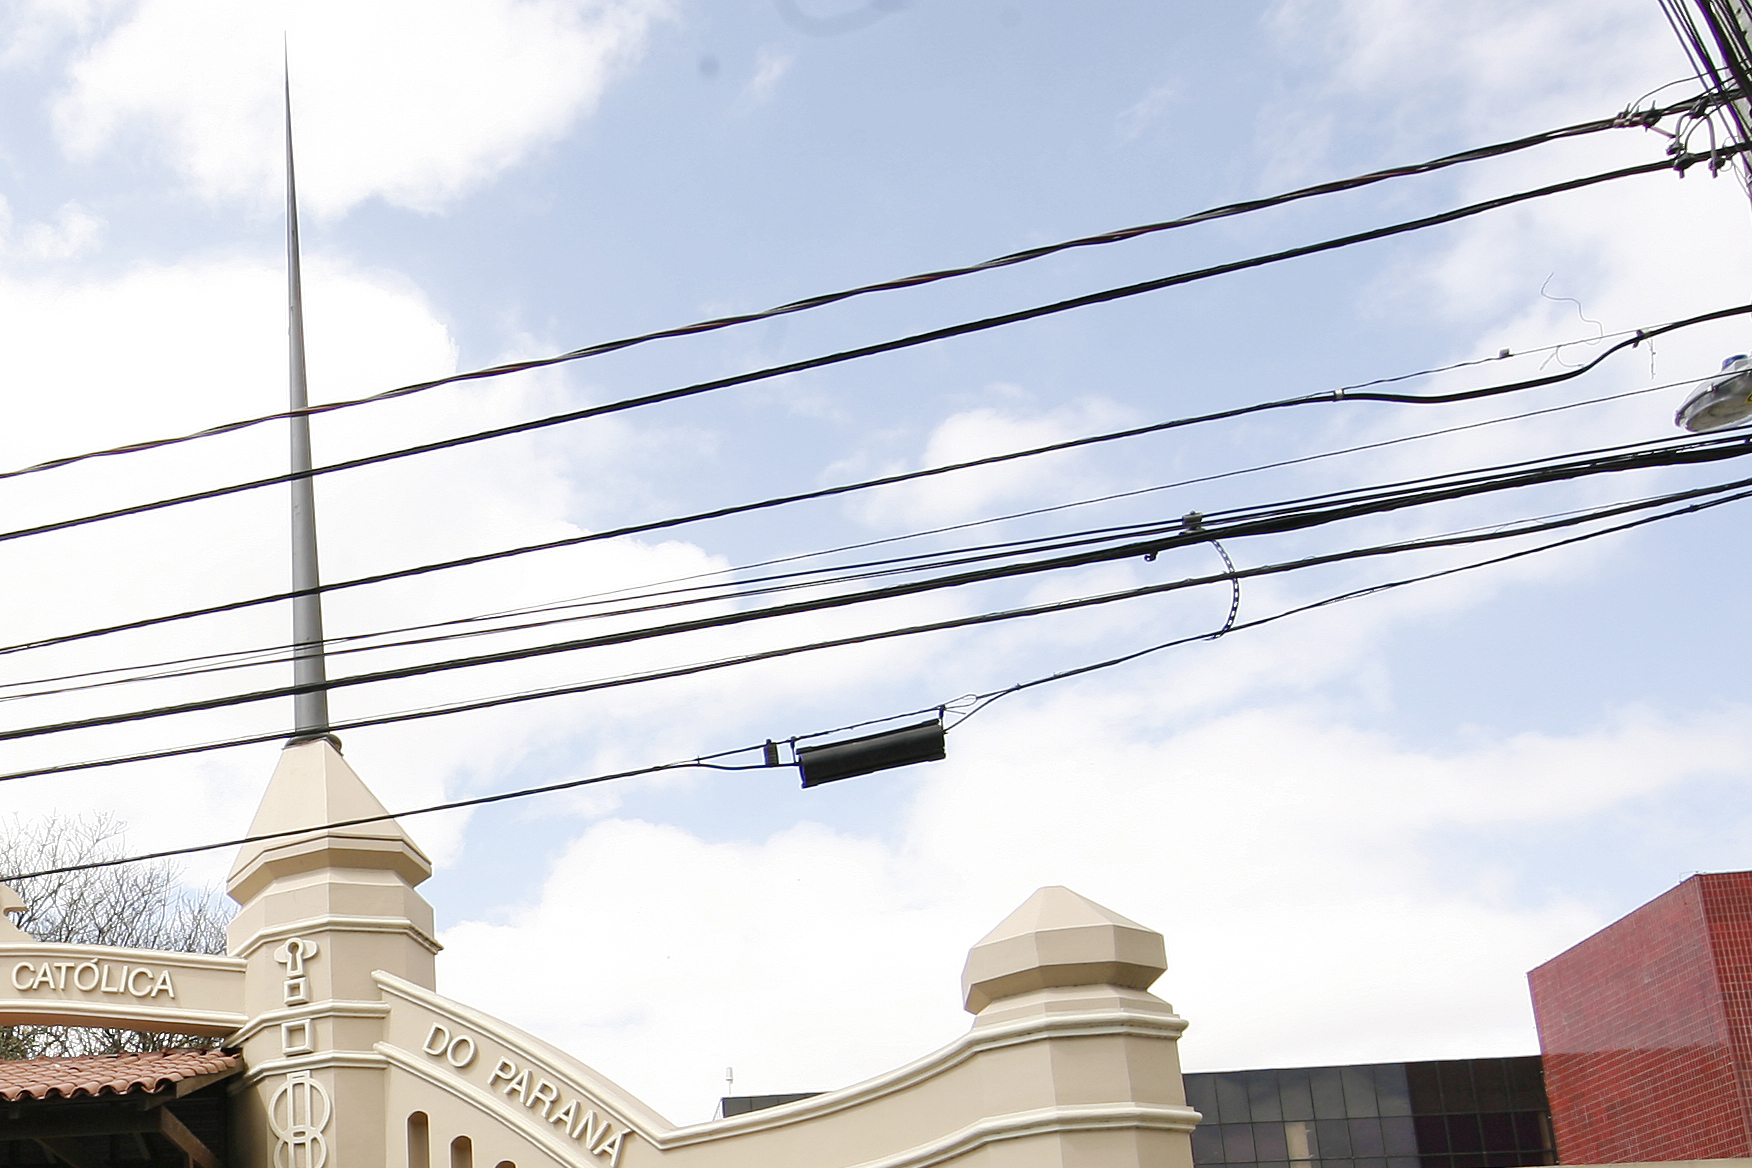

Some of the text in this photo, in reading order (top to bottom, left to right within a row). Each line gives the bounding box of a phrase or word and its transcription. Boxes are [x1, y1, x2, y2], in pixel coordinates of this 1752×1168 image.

[11, 957, 176, 999] CATÓLICA
[421, 1021, 635, 1168] DO PARANÁ
